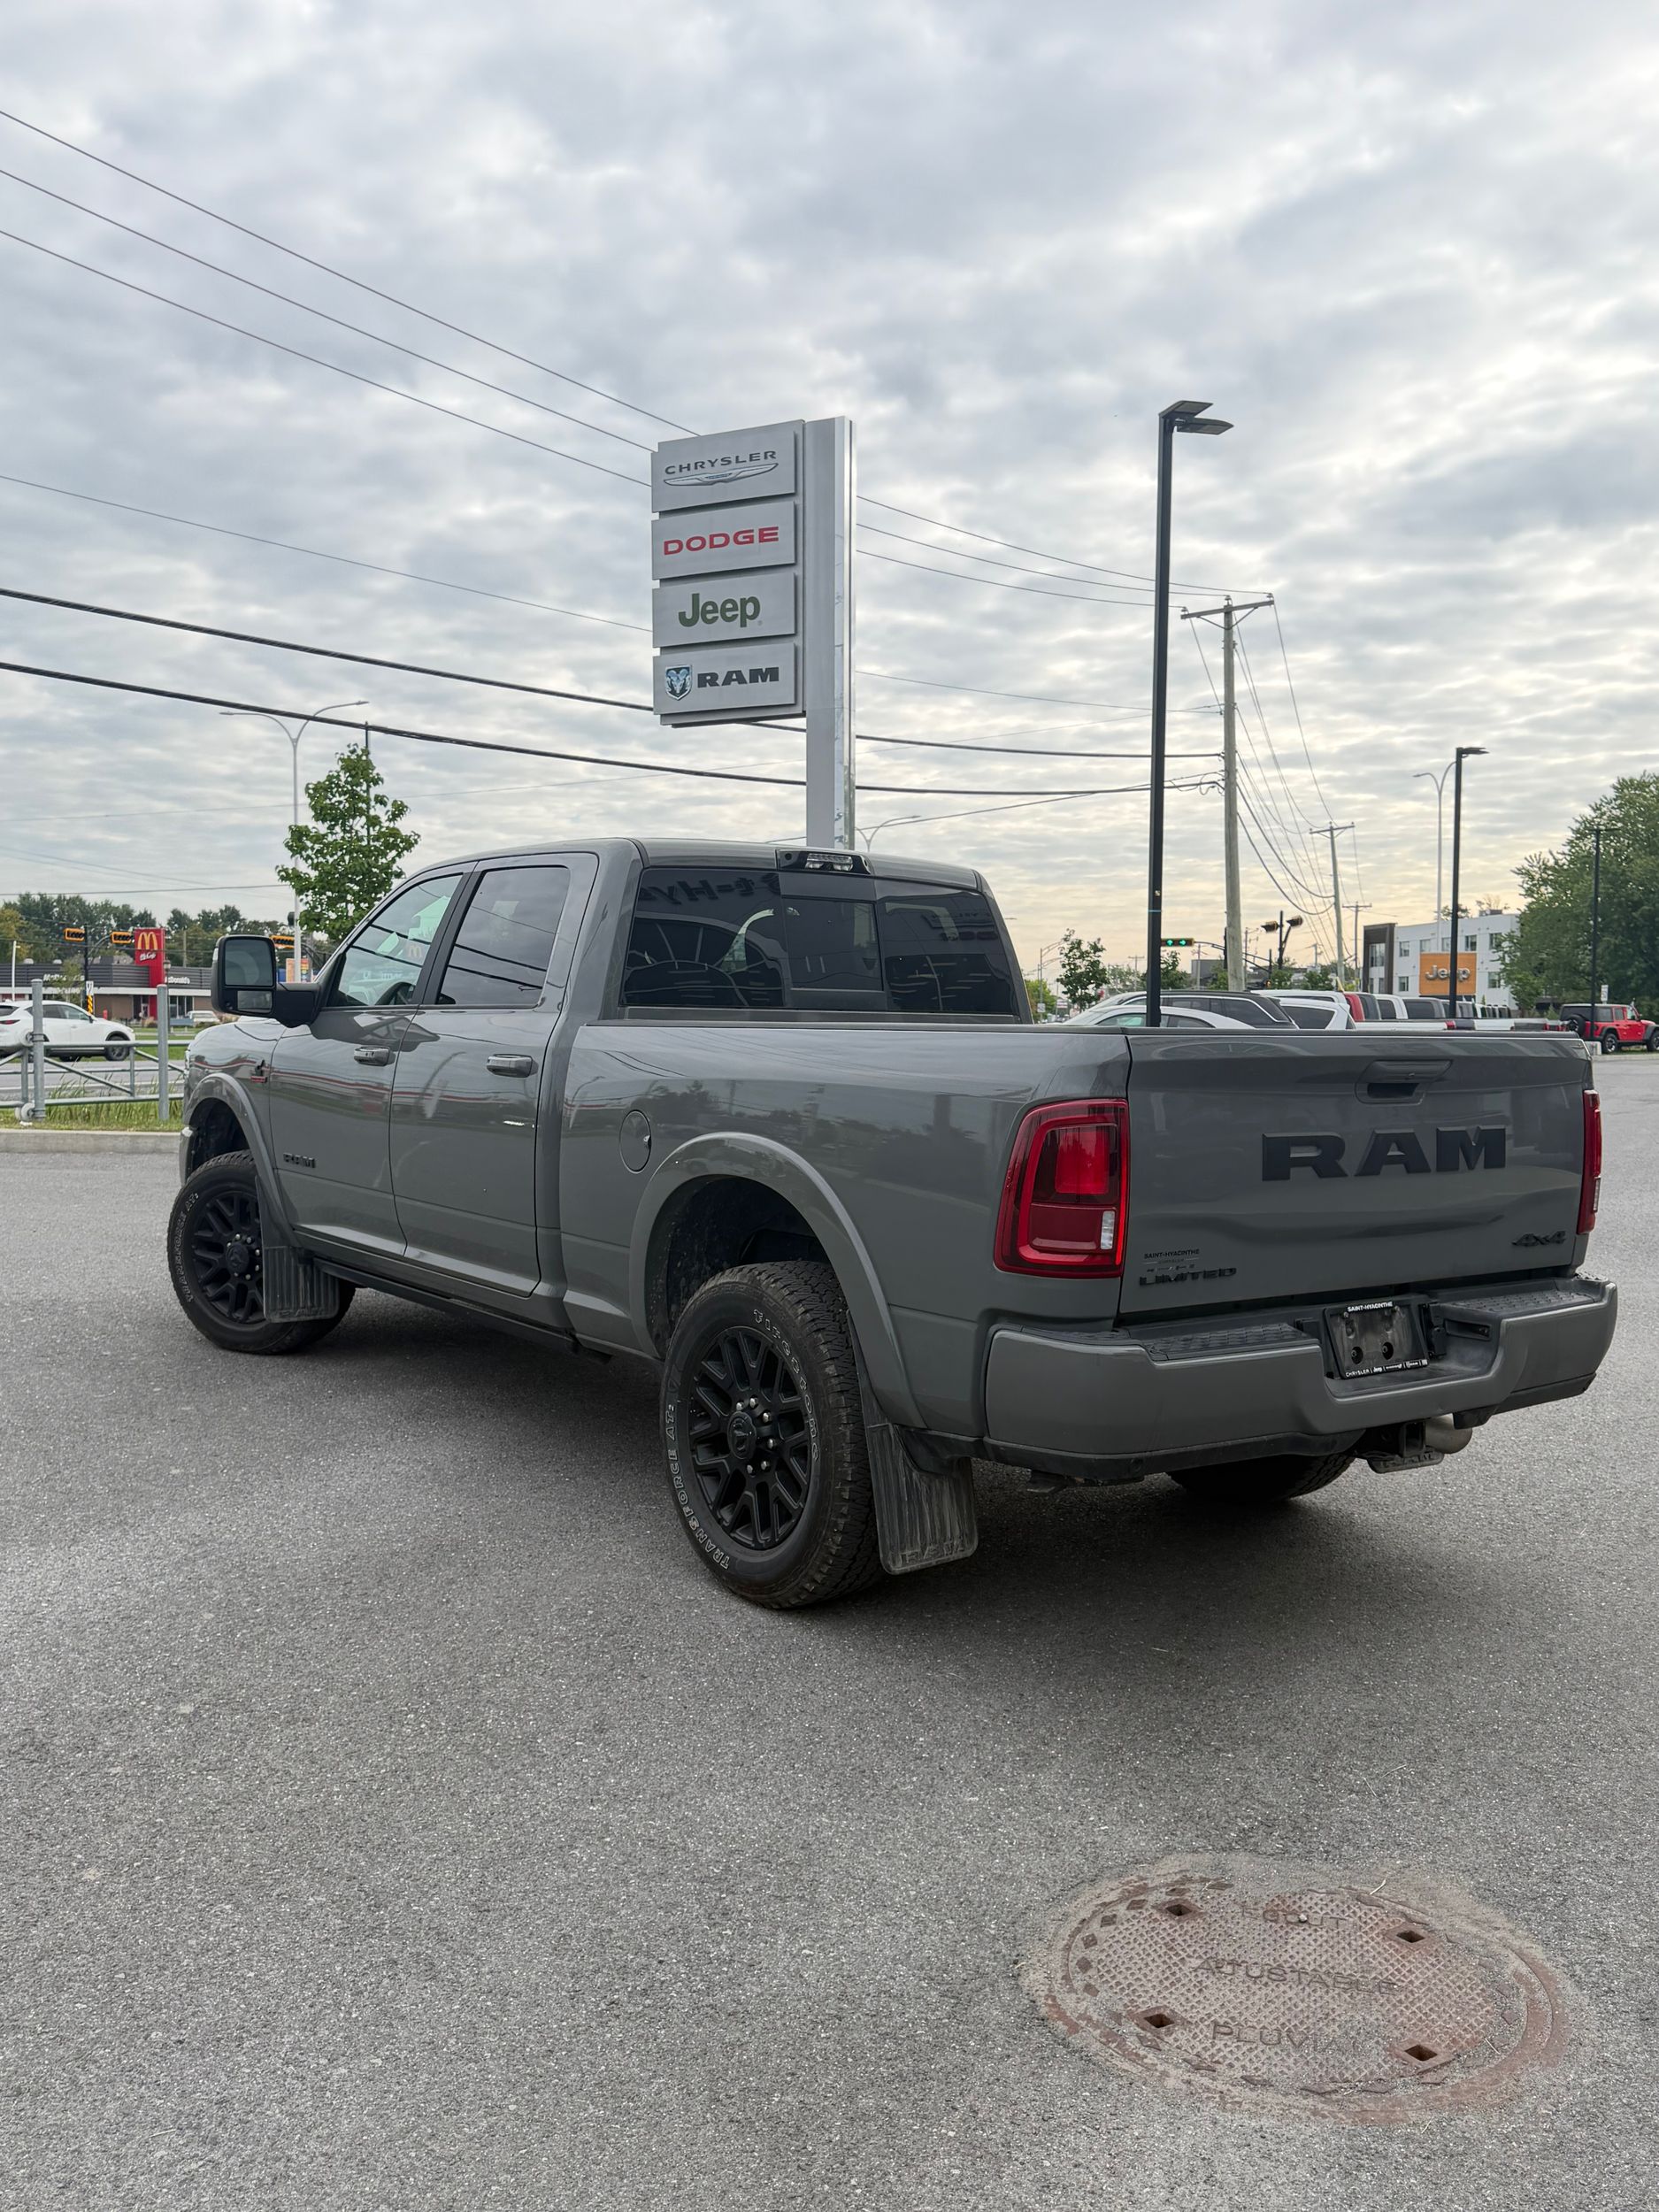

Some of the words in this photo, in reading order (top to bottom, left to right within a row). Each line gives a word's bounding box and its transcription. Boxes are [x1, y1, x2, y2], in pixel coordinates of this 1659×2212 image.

[664, 450, 778, 475] CHRYSLER
[664, 526, 780, 556] DODGE
[678, 593, 761, 628] Jeep
[696, 666, 780, 688] RAM
[165, 976, 190, 985] cDonald's
[1425, 964, 1471, 982] Jep
[1262, 1125, 1507, 1181] RAM
[1144, 1248, 1200, 1259] SAINT-HYACINTHE
[1139, 1267, 1237, 1286] LIMITED
[1348, 1302, 1394, 1312] SAINT-HYACINTHE
[1345, 1369, 1370, 1378] CHRYSLER
[667, 1448, 731, 1570] TRANSFORCE
